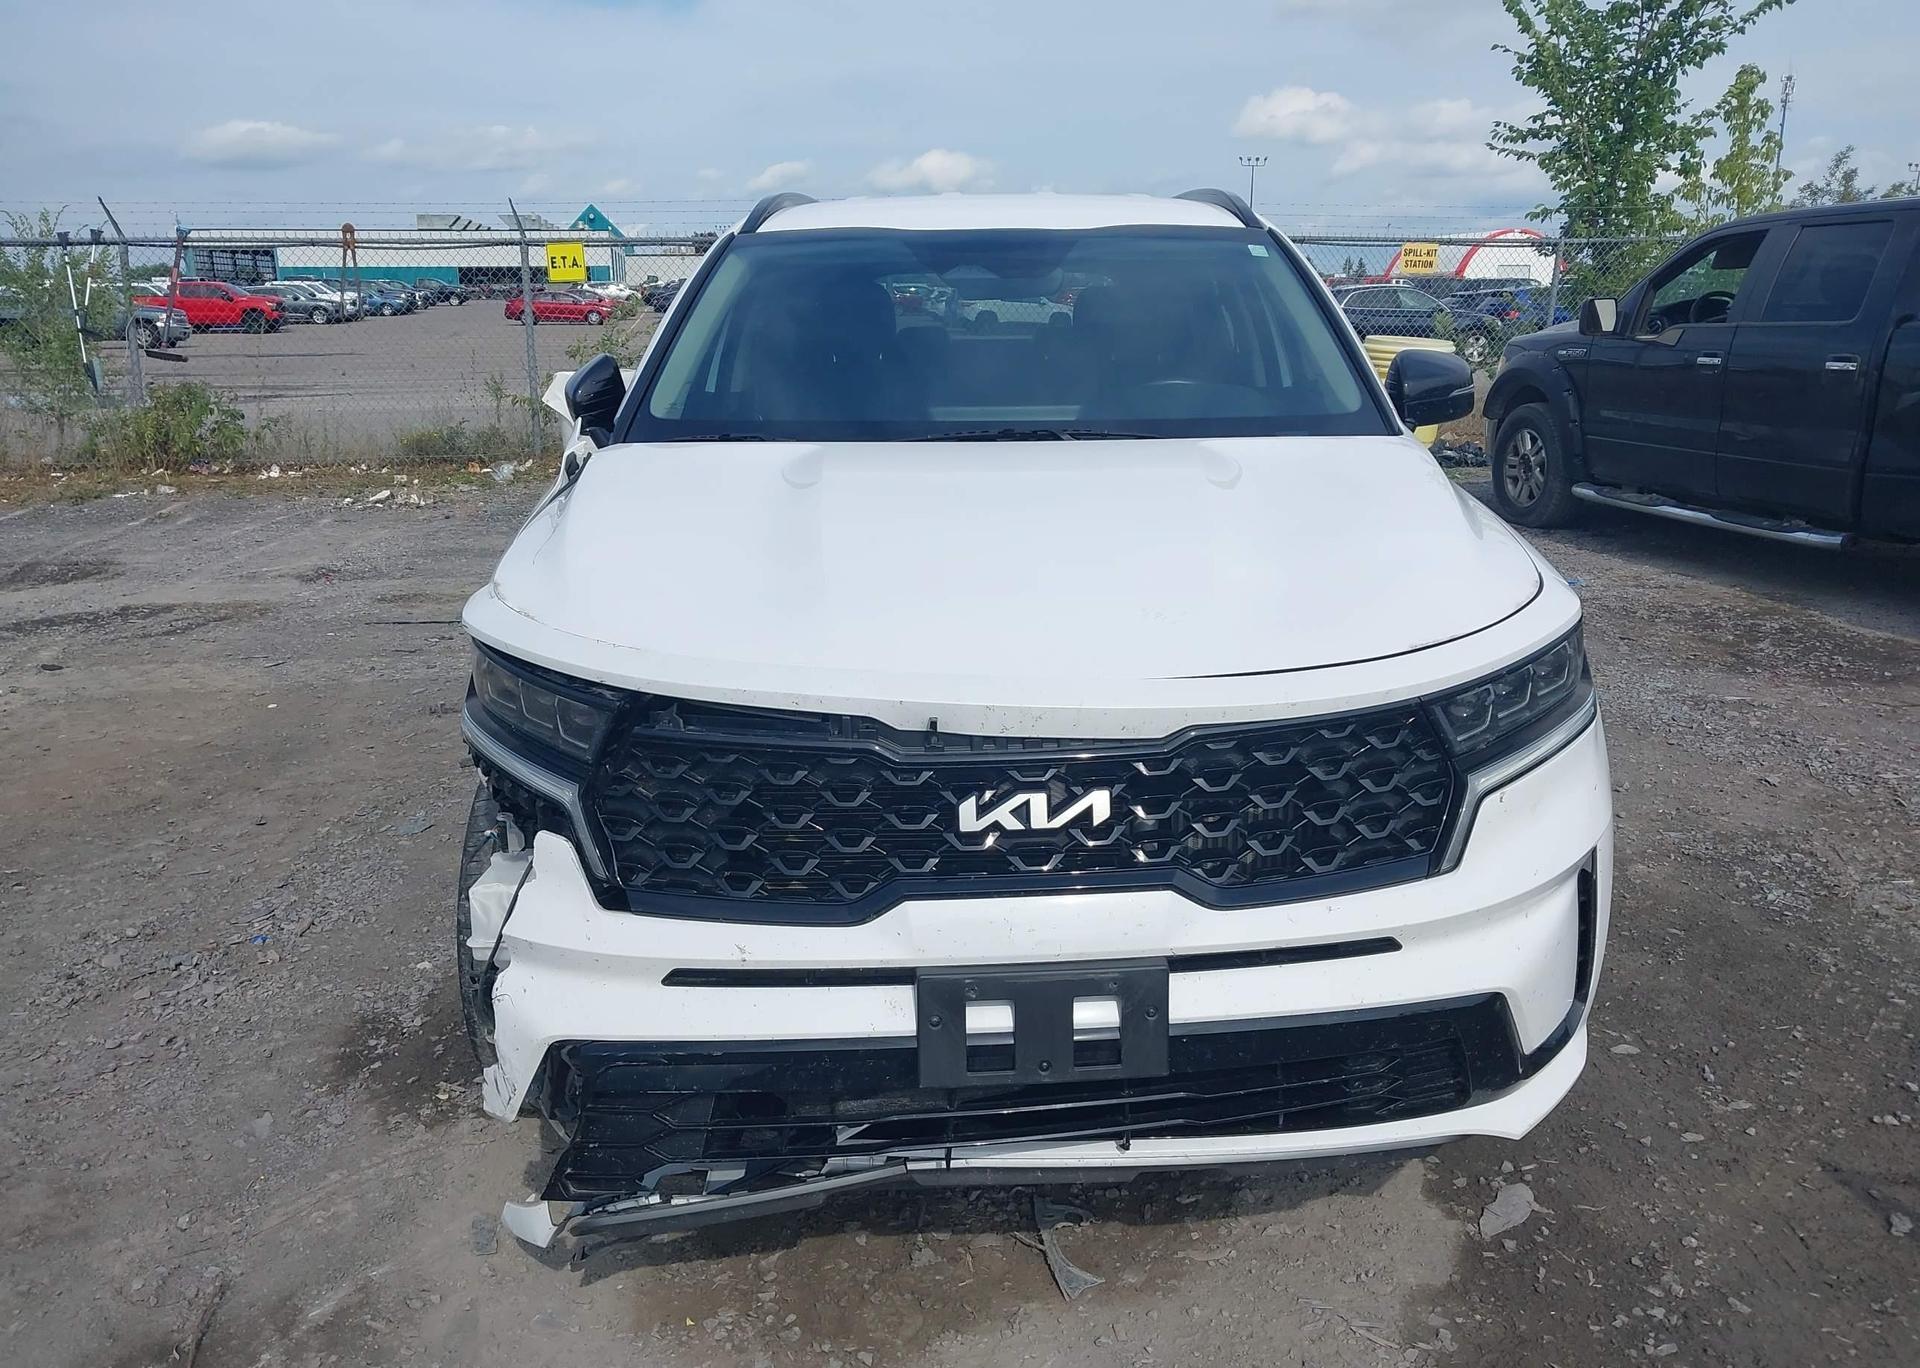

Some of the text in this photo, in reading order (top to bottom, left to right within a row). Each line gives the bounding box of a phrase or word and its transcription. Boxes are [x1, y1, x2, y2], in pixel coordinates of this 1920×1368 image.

[1403, 248, 1438, 257] SPILL-KIT
[550, 255, 582, 269] E.T.A.
[1404, 259, 1434, 269] STATION
[959, 789, 1111, 832] KIA
